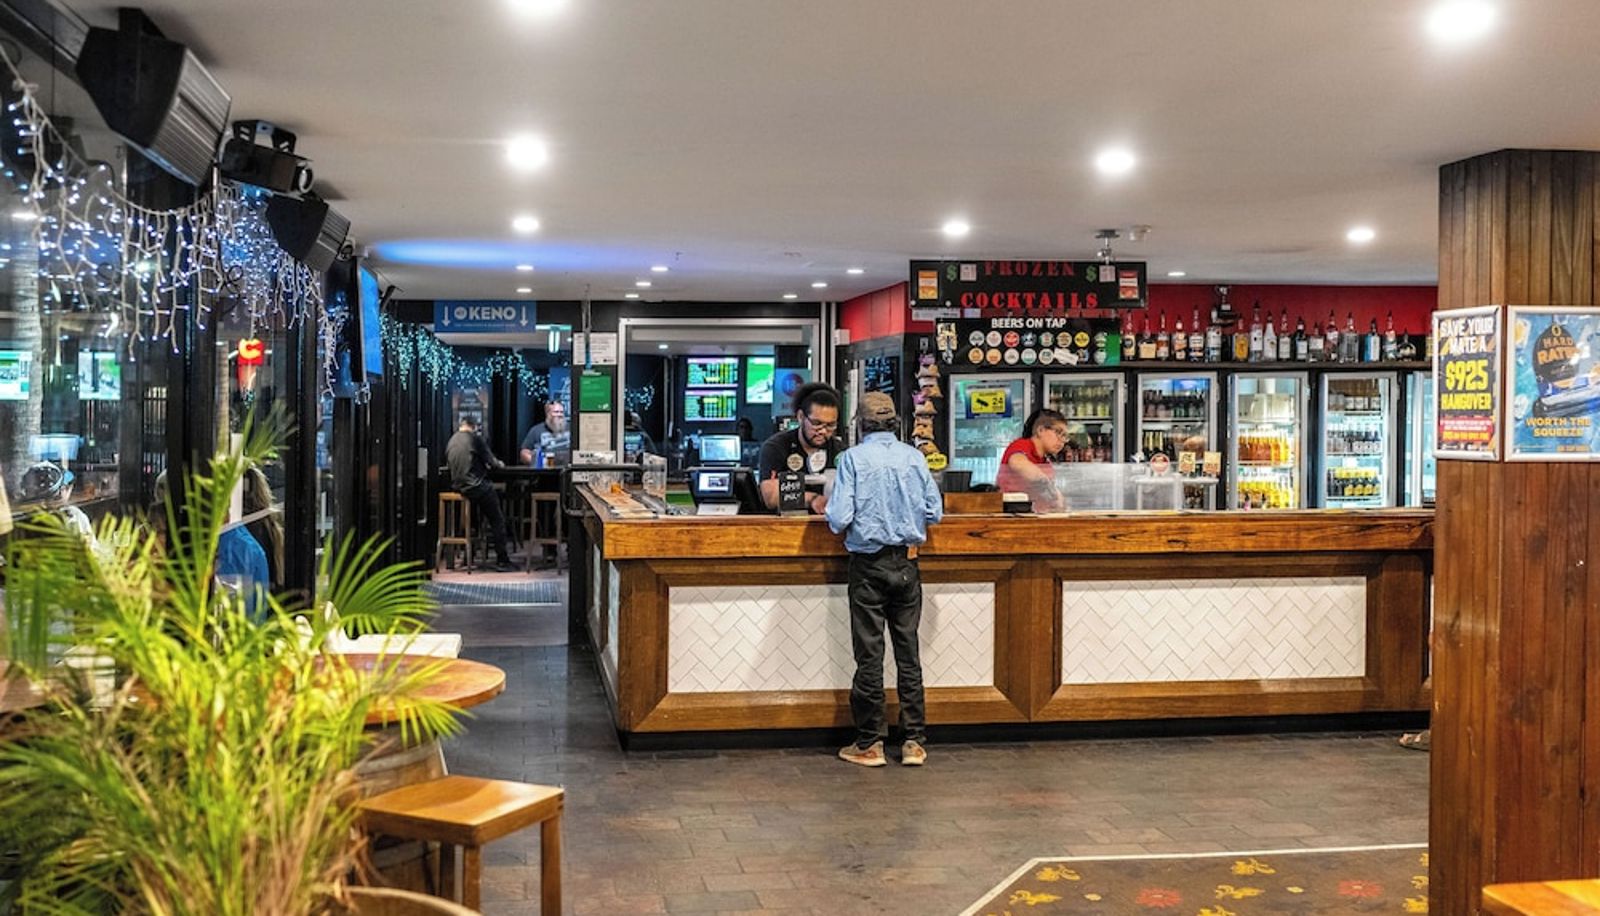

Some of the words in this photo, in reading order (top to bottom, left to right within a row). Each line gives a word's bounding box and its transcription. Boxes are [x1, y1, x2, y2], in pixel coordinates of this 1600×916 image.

[983, 261, 1075, 276] FROZEN
[960, 292, 1099, 309] COCKTAILS
[468, 306, 516, 321] KENO
[991, 318, 1024, 329] BEERS
[1025, 318, 1043, 329] ON
[1045, 318, 1067, 329] TAP
[1440, 318, 1466, 337] SAVE
[1467, 317, 1494, 336] YOUR
[1479, 335, 1488, 353] A
[1543, 337, 1574, 348] HARD
[1446, 359, 1489, 391] $925
[1441, 393, 1492, 410] HANGOVER
[1526, 417, 1567, 427] WORTH
[1569, 416, 1591, 426] THE
[1533, 428, 1584, 438] SQUEEZE
